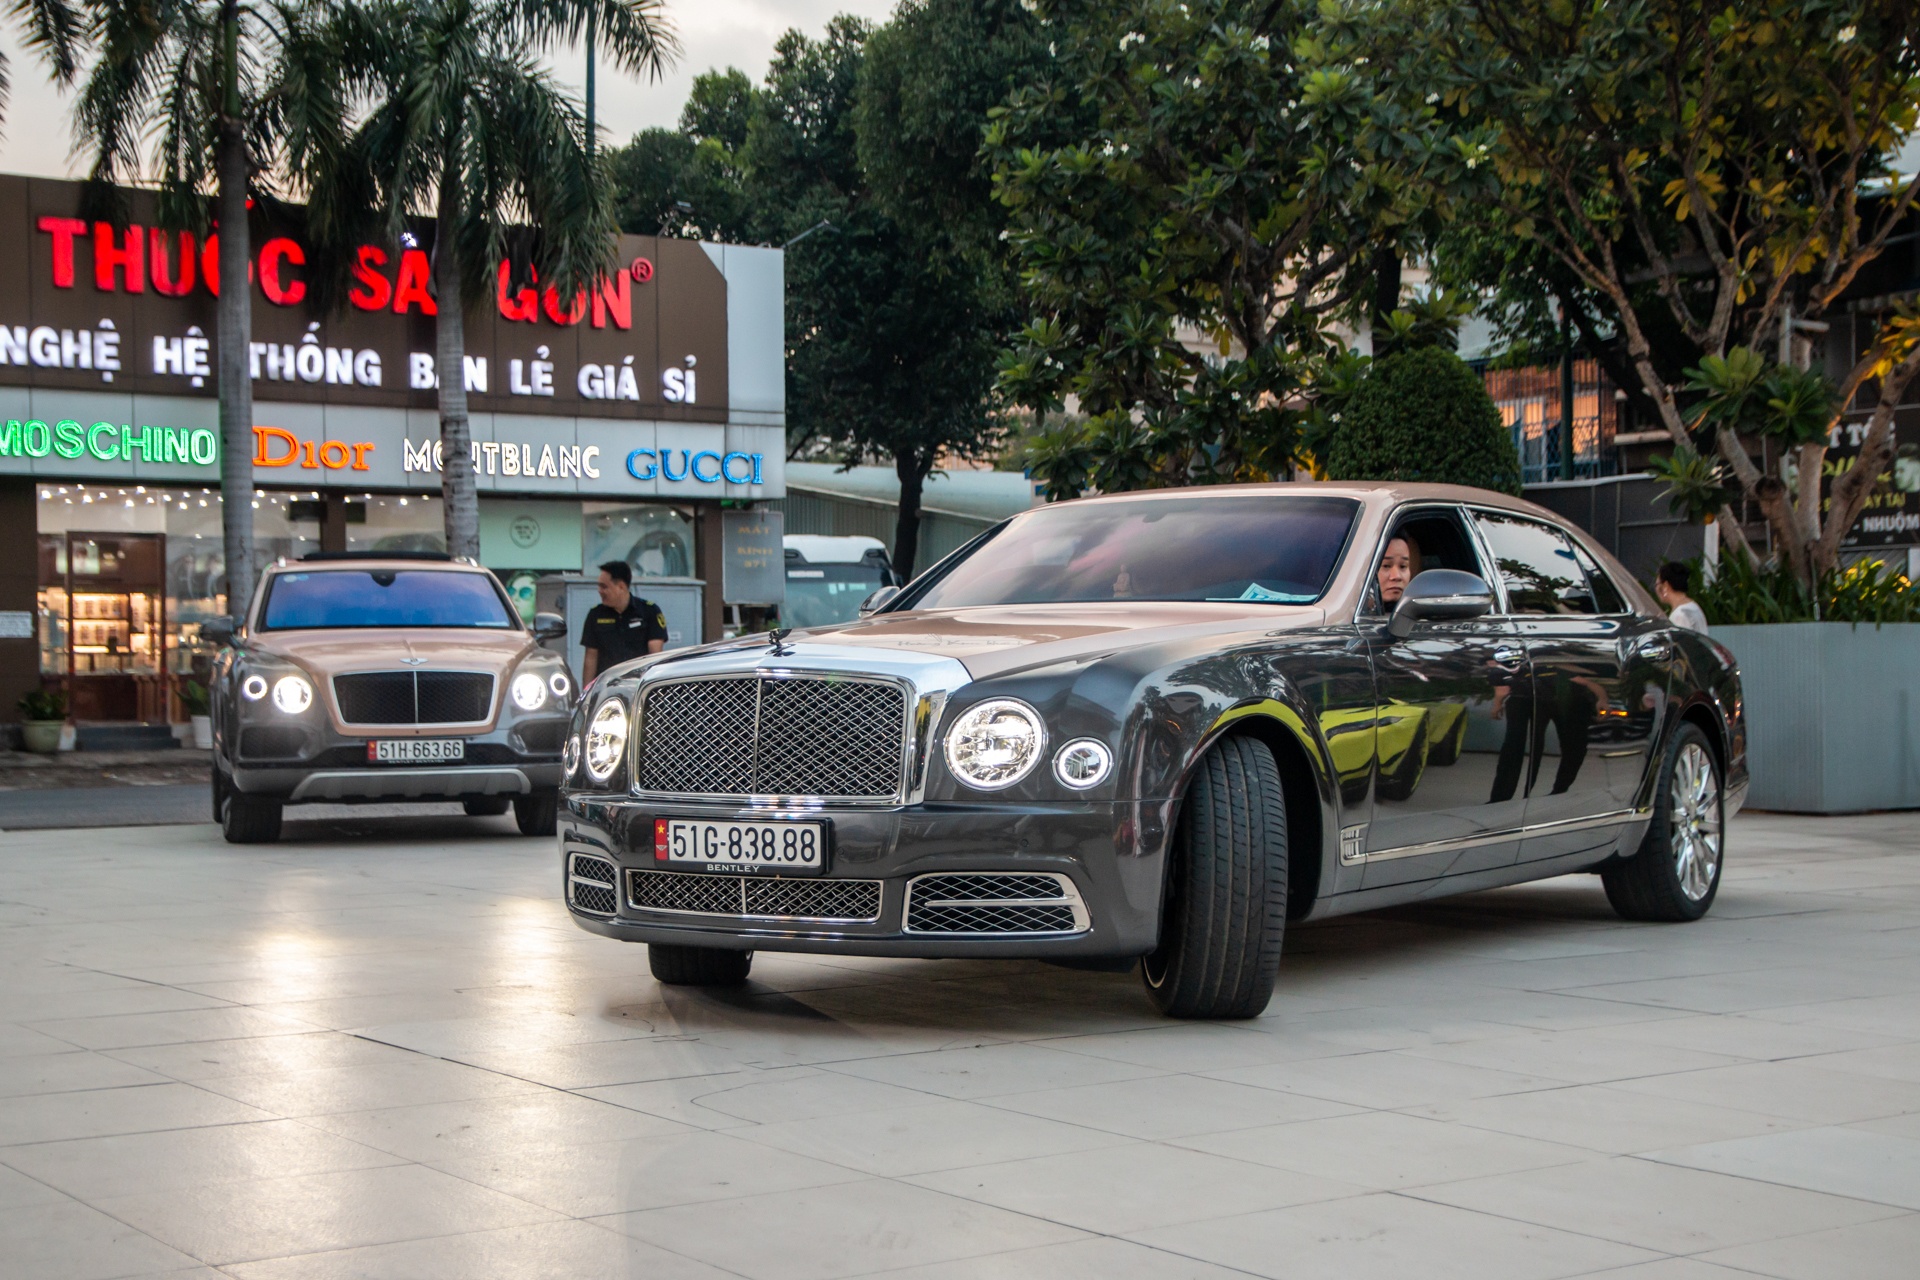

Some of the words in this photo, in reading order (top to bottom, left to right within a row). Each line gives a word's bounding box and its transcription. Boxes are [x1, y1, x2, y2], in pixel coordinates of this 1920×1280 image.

[0, 318, 121, 382] NGHỆ
[153, 325, 211, 387] HỆ
[249, 321, 382, 386] THỐNG
[409, 352, 488, 393] BN
[510, 345, 555, 396] LẺ
[577, 355, 640, 400] GIÁ
[662, 354, 697, 404] SỈ
[0, 419, 216, 465] MOSCHINO
[252, 425, 375, 470] Dior
[626, 447, 764, 484] GUCCI
[380, 742, 461, 758] 51H-663.66
[673, 824, 815, 862] 51G-838.88
[707, 863, 760, 873] BENTLEY
